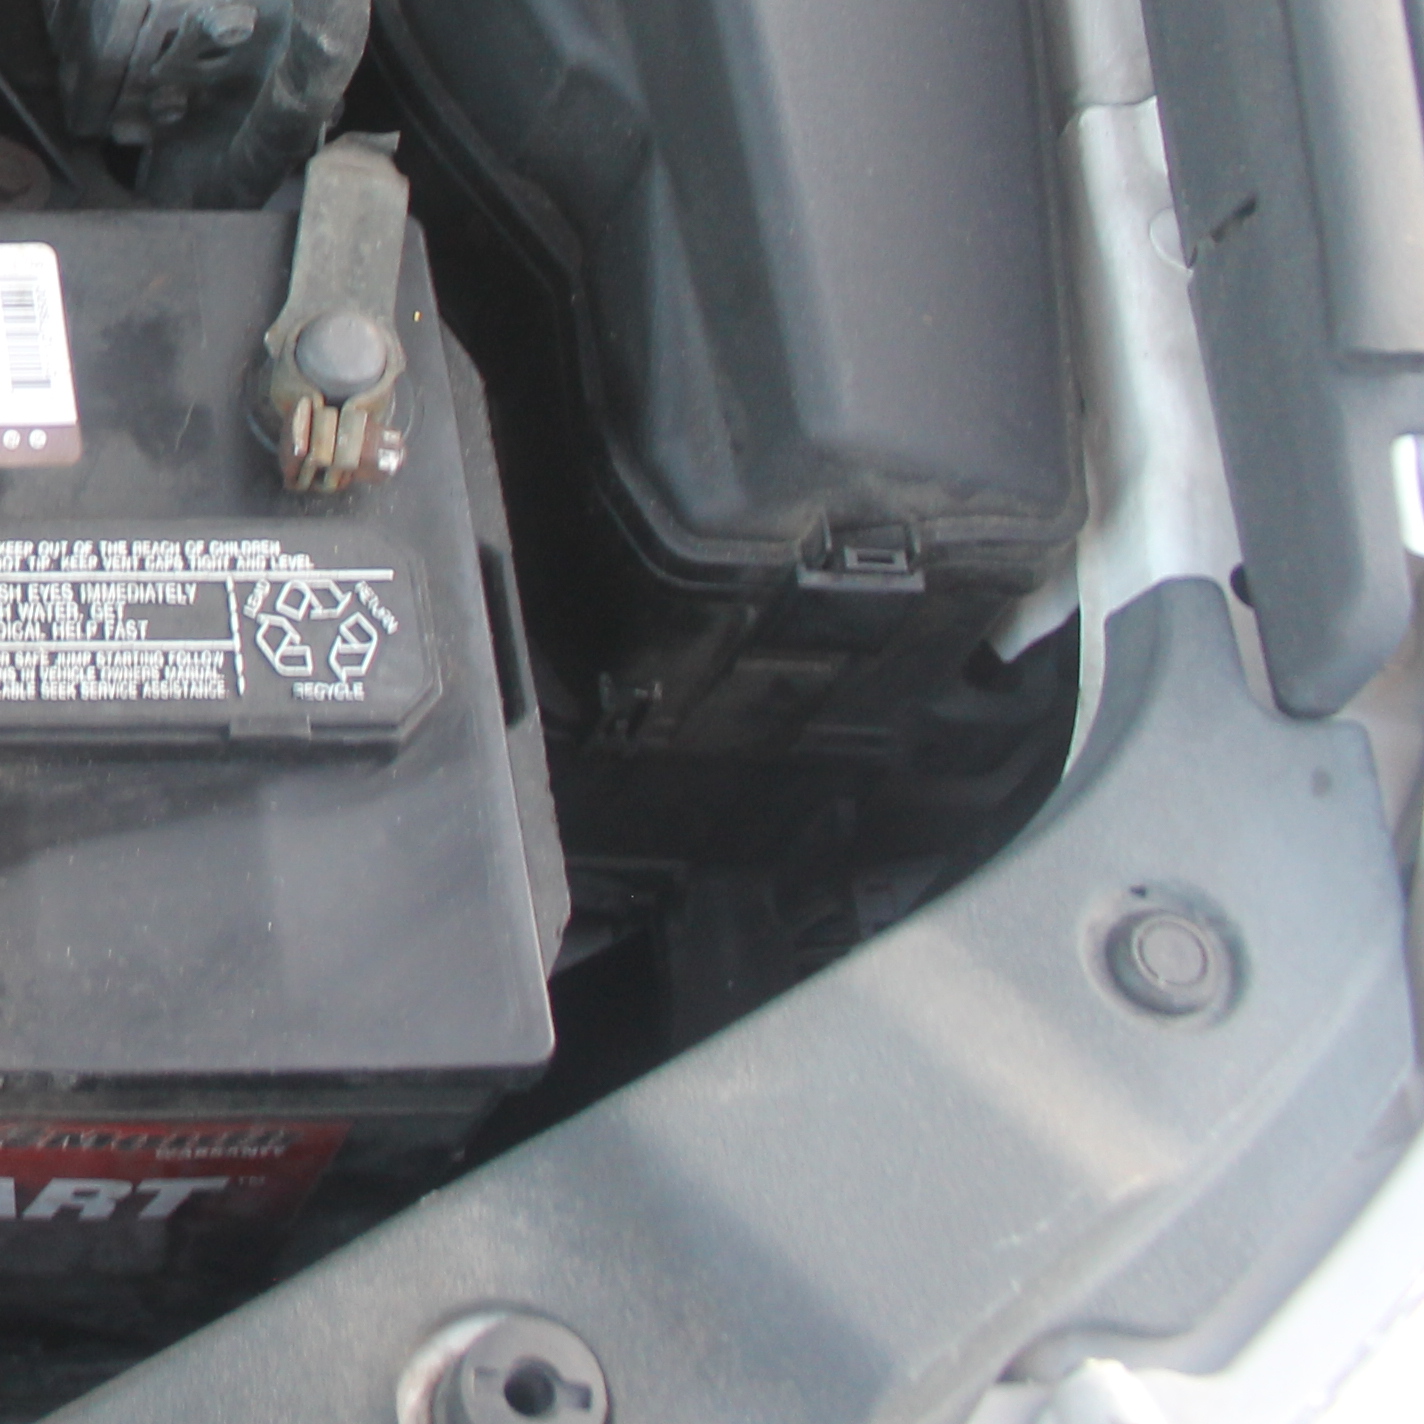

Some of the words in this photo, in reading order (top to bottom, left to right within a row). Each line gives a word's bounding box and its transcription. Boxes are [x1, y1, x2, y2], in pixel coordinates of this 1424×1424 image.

[38, 540, 69, 558] OUT
[73, 540, 93, 558] OF
[100, 540, 128, 558] THE
[132, 540, 180, 558] REACH
[185, 540, 205, 558] OF
[209, 540, 281, 558] CHILDREN
[27, 582, 74, 605] EYES
[80, 582, 197, 605] IMMEDIATELY
[91, 601, 125, 624] GET
[52, 620, 98, 642] HELP
[104, 620, 149, 642] FAST
[96, 650, 164, 669] STARTING
[292, 681, 365, 701] RECYCLE
